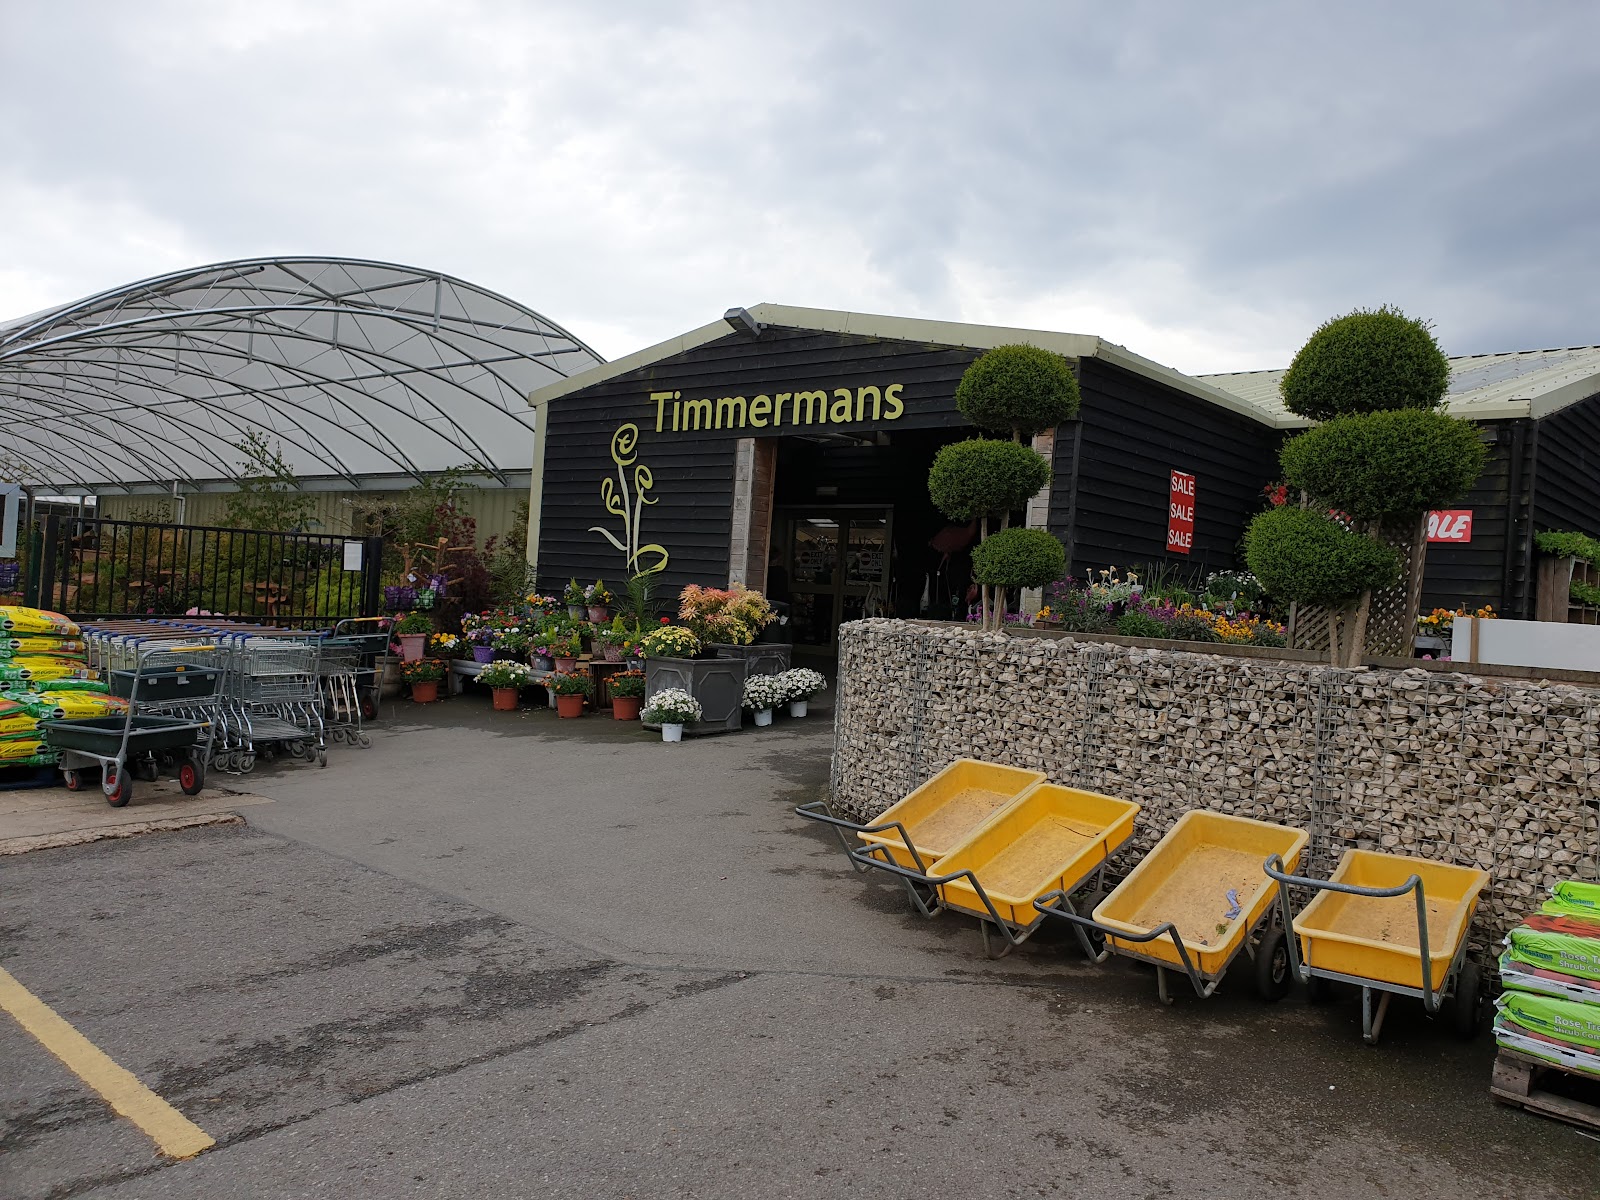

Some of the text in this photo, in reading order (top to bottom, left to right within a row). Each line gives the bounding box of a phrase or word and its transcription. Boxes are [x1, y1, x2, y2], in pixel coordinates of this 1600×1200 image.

[650, 383, 904, 433] Timmermans
[1171, 476, 1194, 496] SALE
[1170, 502, 1194, 522] SALE
[1427, 513, 1471, 539] ALE
[1168, 529, 1192, 548] SALE
[1559, 959, 1586, 971] Shrub
[1560, 950, 1589, 964] Rose,
[1553, 1025, 1580, 1037] Shrub
[1554, 1015, 1584, 1030] Rose,
